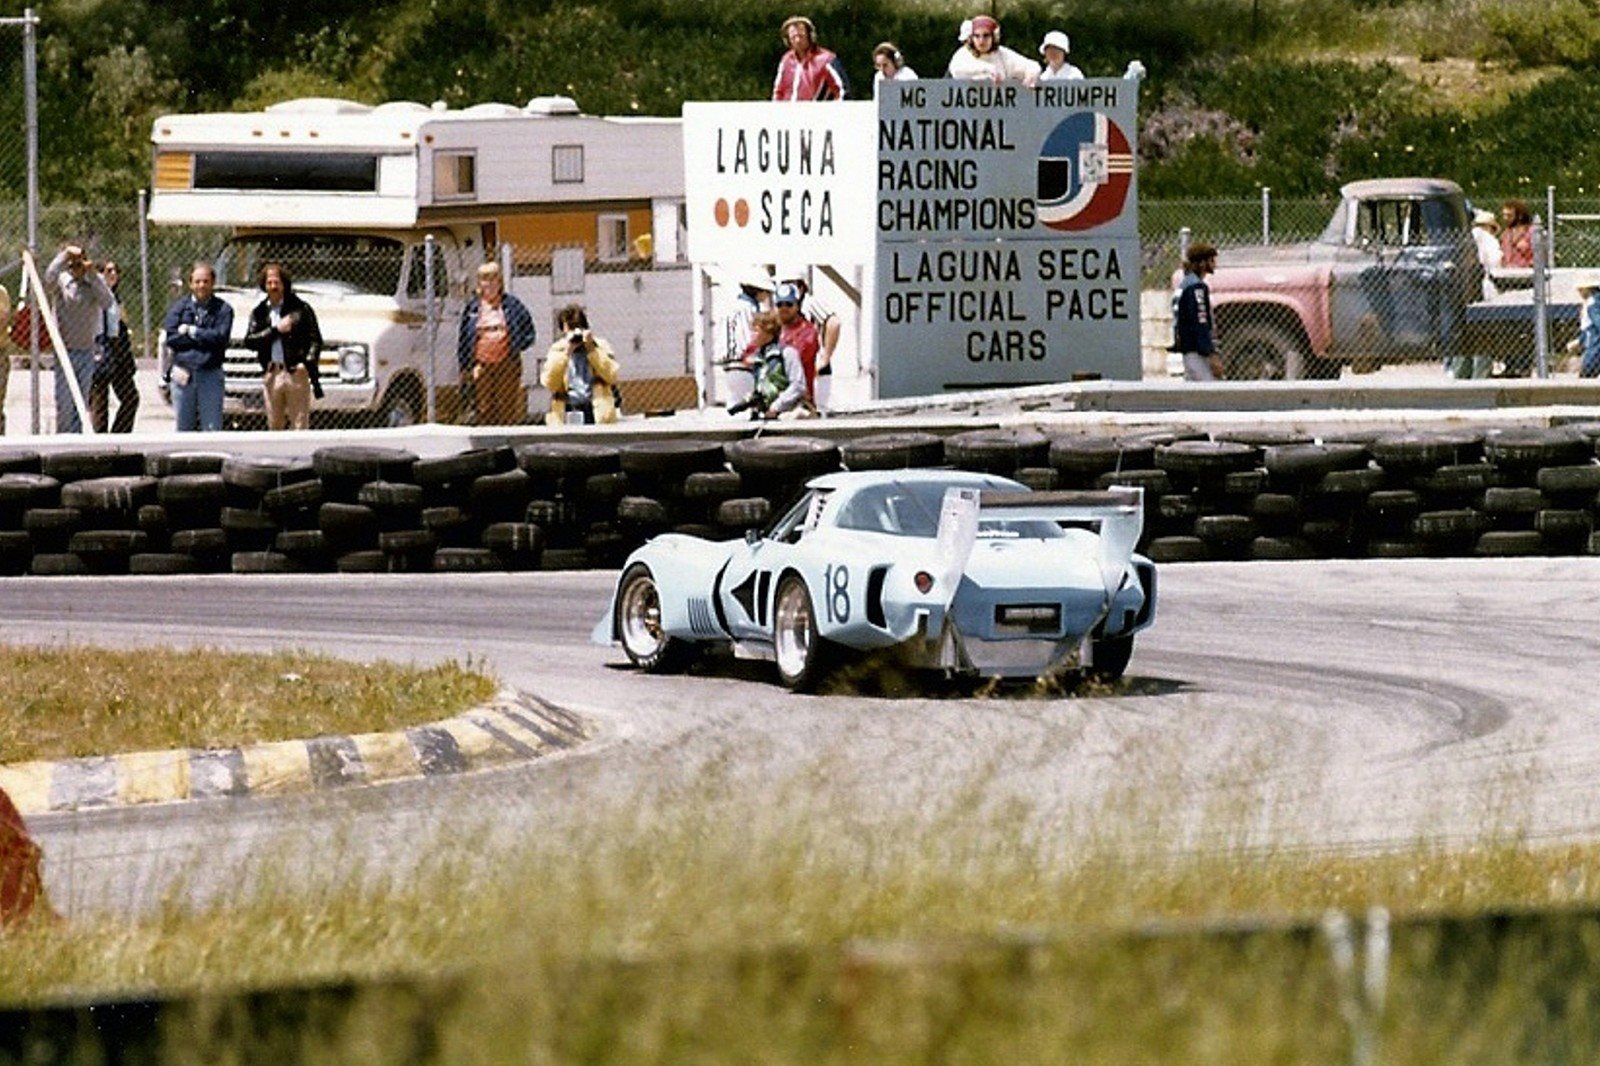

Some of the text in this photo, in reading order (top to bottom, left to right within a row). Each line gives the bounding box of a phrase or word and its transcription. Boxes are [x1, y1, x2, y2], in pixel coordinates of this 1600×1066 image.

[900, 86, 1117, 109] MG JAGUAR TRIUMPH
[878, 119, 1015, 151] NATIONAL
[716, 128, 835, 176] LAGUNA
[878, 160, 977, 191] RACING
[761, 189, 833, 236] SECA
[878, 199, 1035, 231] CHAMPIONS
[893, 248, 1121, 283] LAGUNA SECA
[886, 289, 1128, 323] OFFICIAL PACE
[967, 330, 1046, 362] CARS
[824, 563, 850, 624] 18
